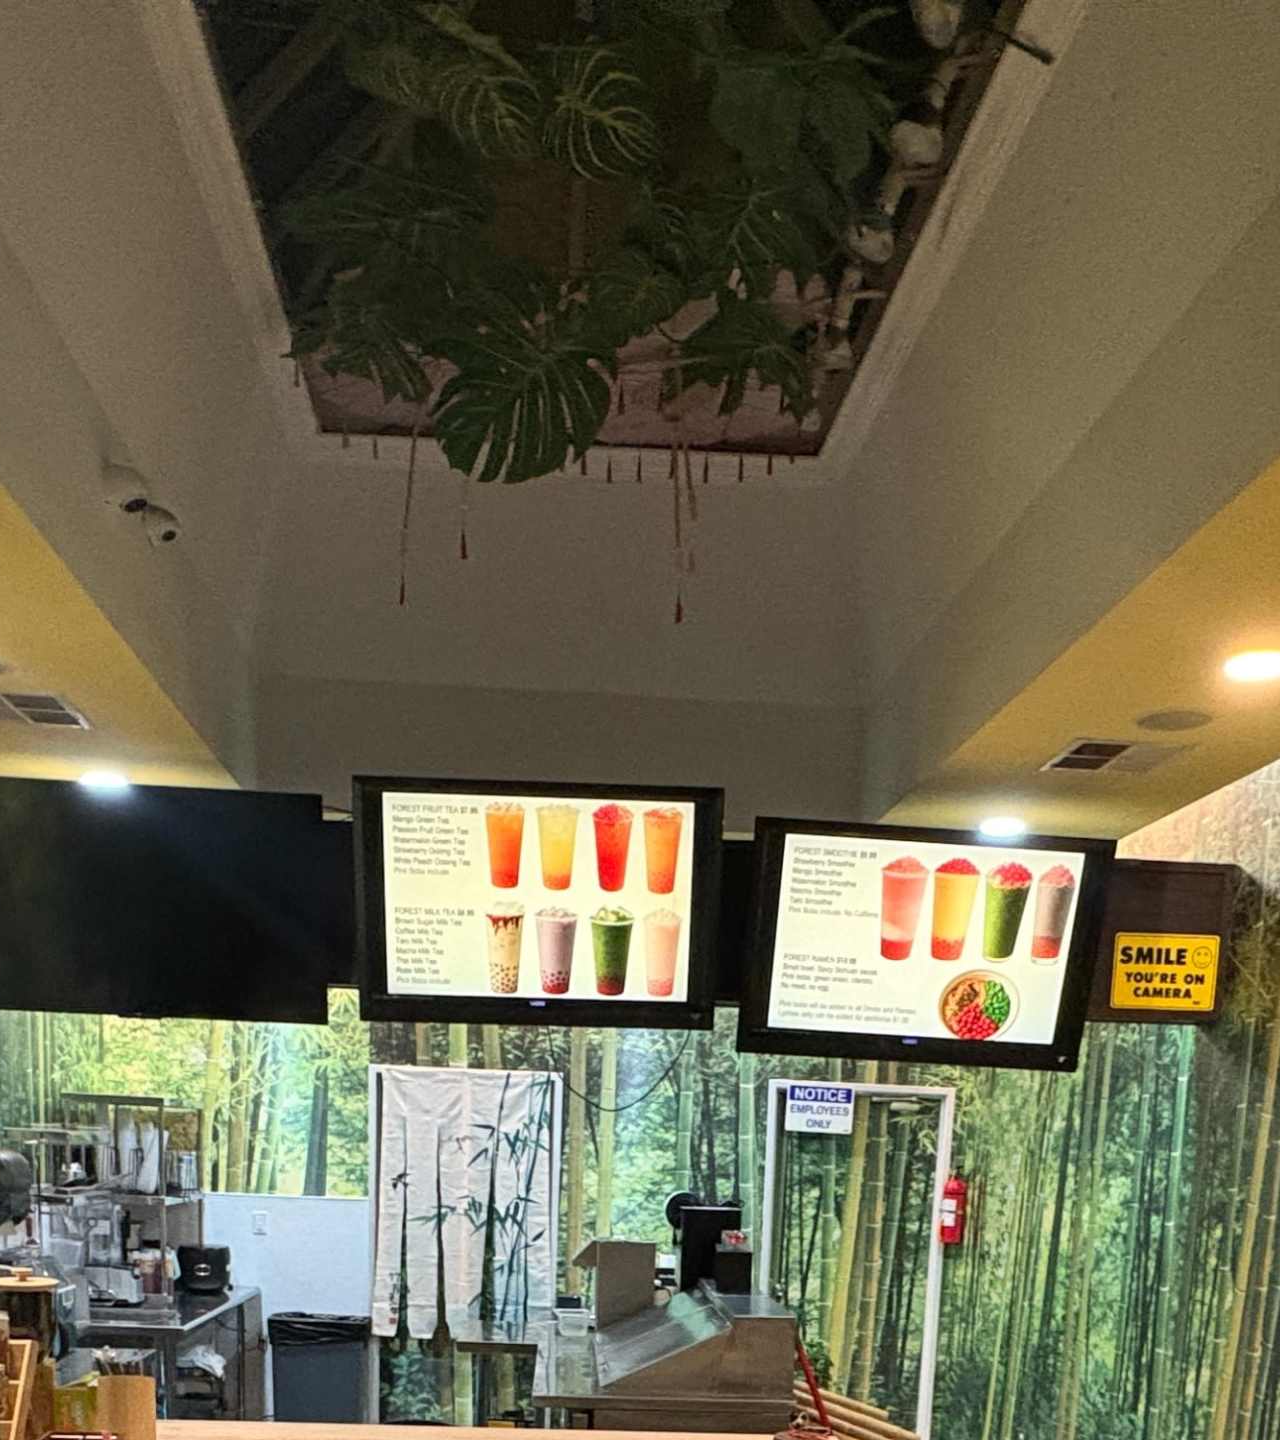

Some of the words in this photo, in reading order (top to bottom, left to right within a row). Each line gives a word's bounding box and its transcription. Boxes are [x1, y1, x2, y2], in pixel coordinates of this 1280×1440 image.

[392, 804, 420, 813] FOREST
[422, 805, 442, 813] FRUIT
[446, 806, 459, 814] TEA
[794, 847, 821, 855] FOREST
[394, 907, 422, 915] FOREST
[424, 908, 440, 916] MILK
[442, 908, 457, 916] TEA
[1120, 946, 1188, 965] SMILE
[1125, 972, 1177, 984] YOU'RE
[1184, 974, 1205, 985] ON
[1133, 987, 1192, 999] CAMERA
[794, 1088, 848, 1103] NOTICE
[790, 1104, 849, 1117] EMPLOYEES
[806, 1119, 832, 1129] ONLY
